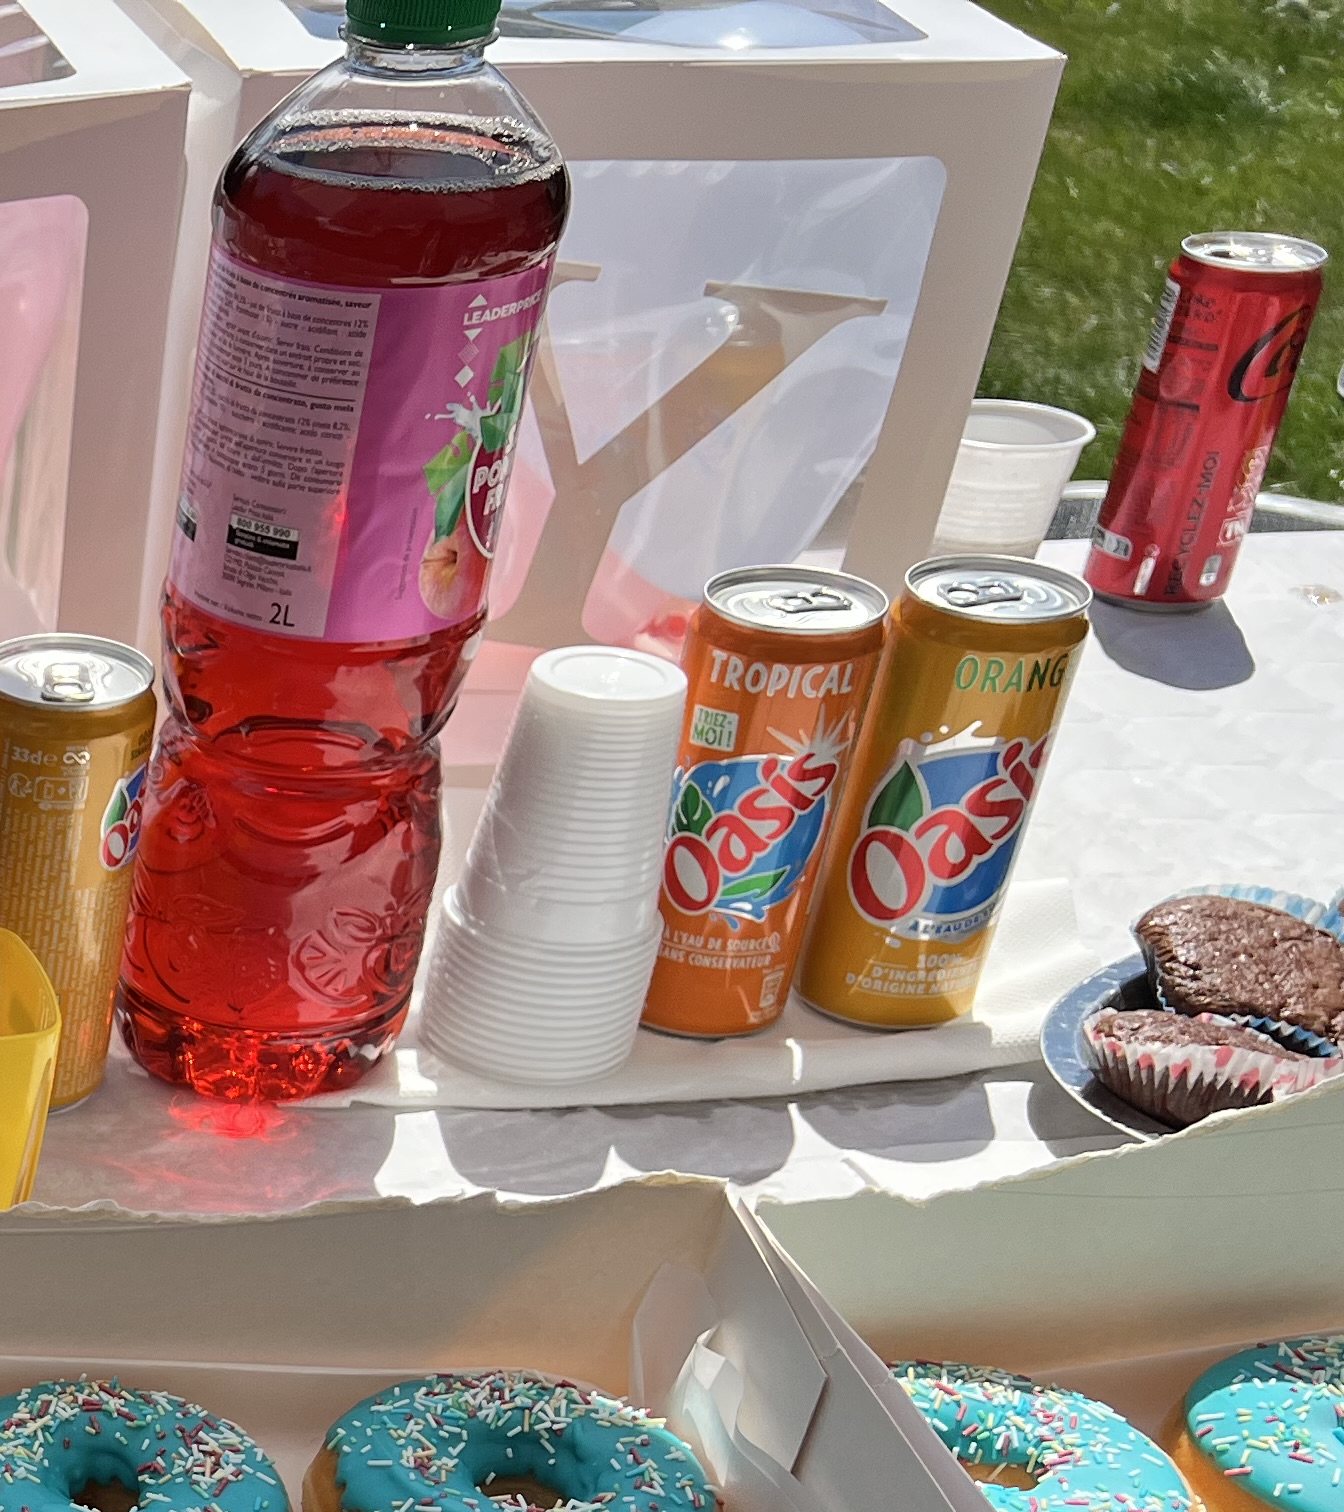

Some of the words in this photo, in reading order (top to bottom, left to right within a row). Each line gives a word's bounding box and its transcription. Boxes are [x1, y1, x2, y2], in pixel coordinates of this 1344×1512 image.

[269, 602, 295, 627] 2L
[710, 649, 854, 698] TROPICAL
[665, 751, 839, 912] Oasis
